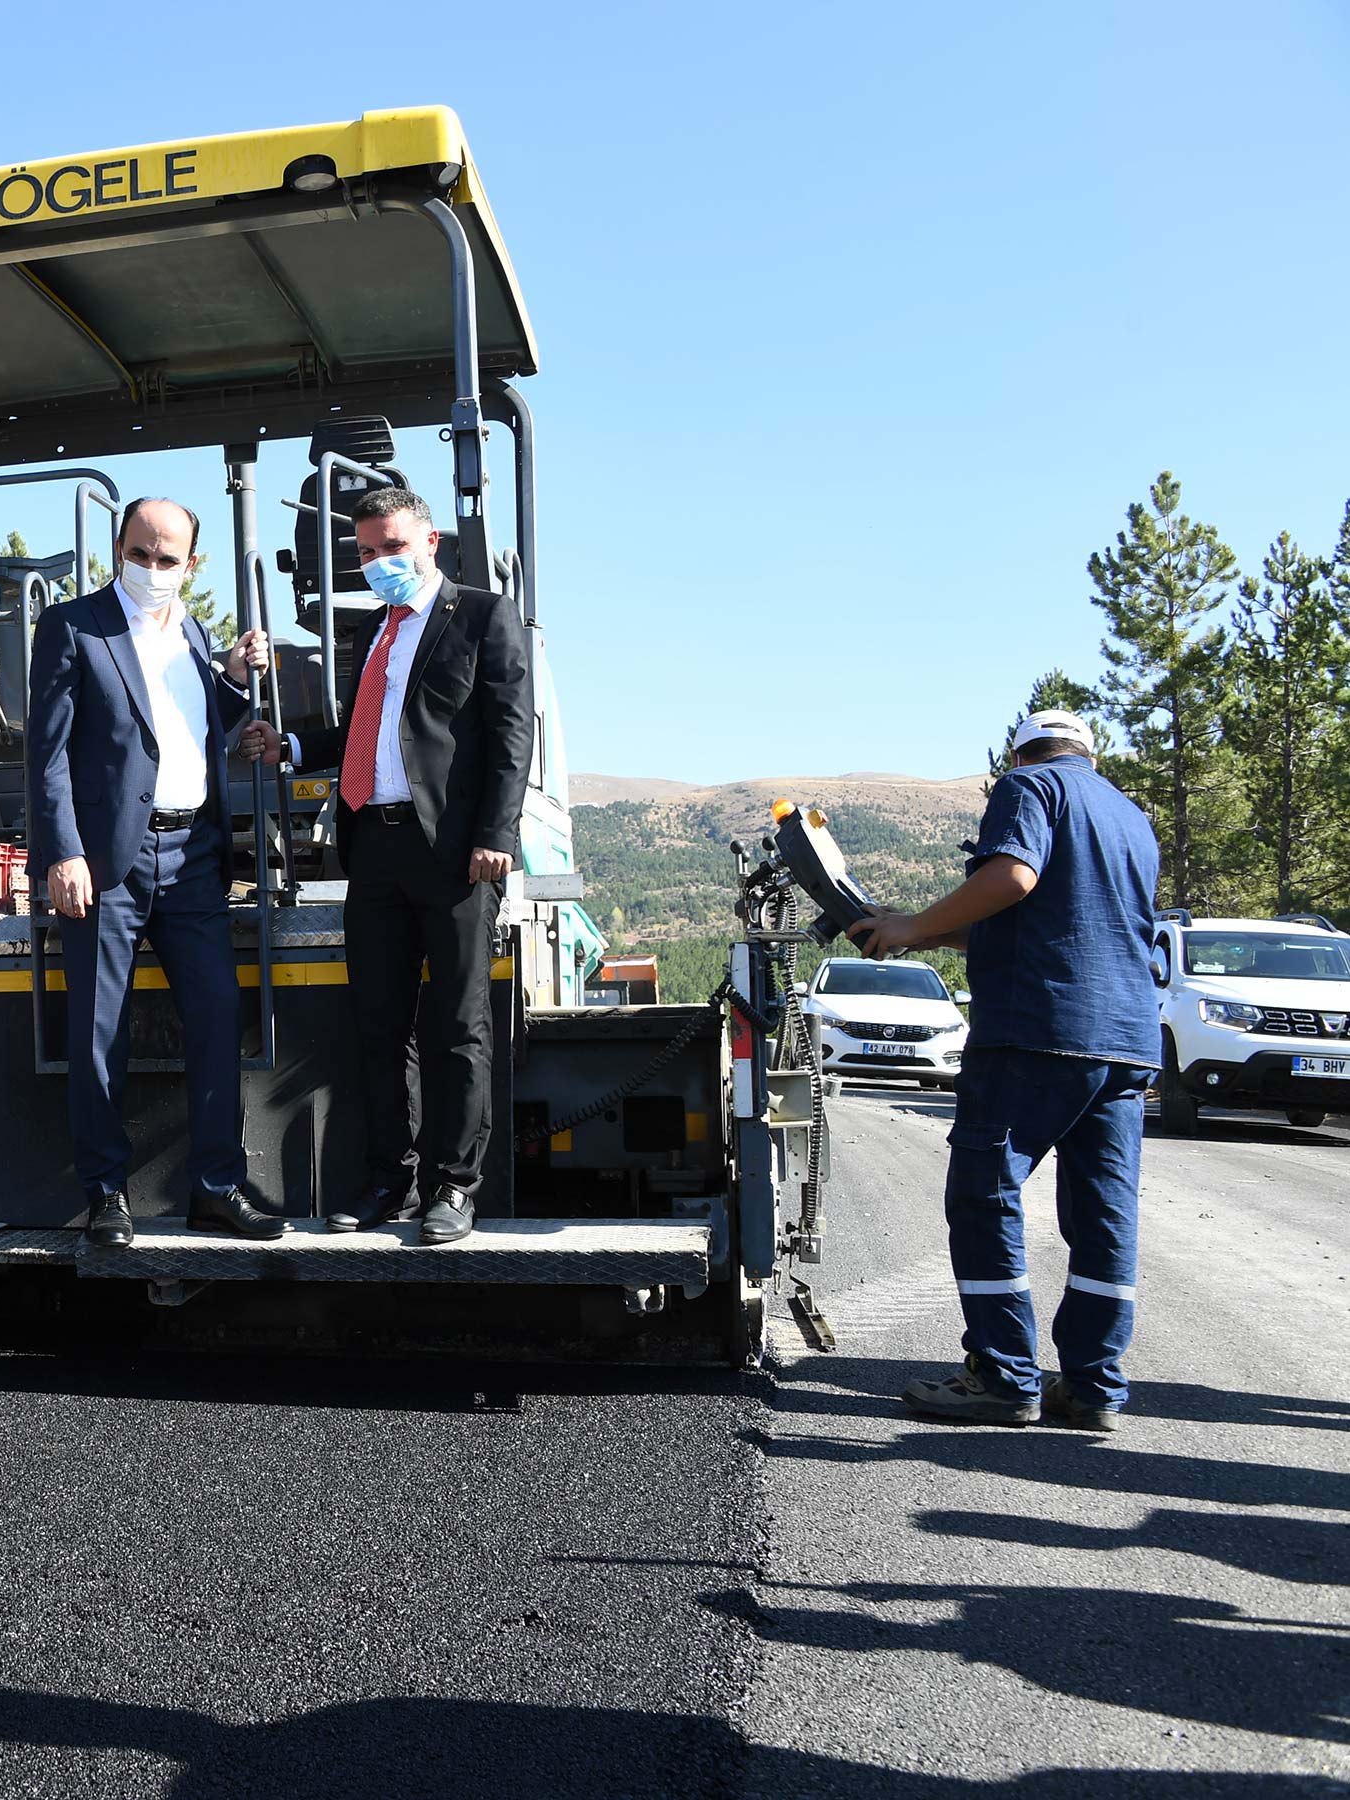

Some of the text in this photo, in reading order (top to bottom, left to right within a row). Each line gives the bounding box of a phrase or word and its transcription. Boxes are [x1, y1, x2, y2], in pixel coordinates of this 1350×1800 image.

[869, 1044, 914, 1055] 42 AAY 078
[1301, 1058, 1315, 1071] 34
